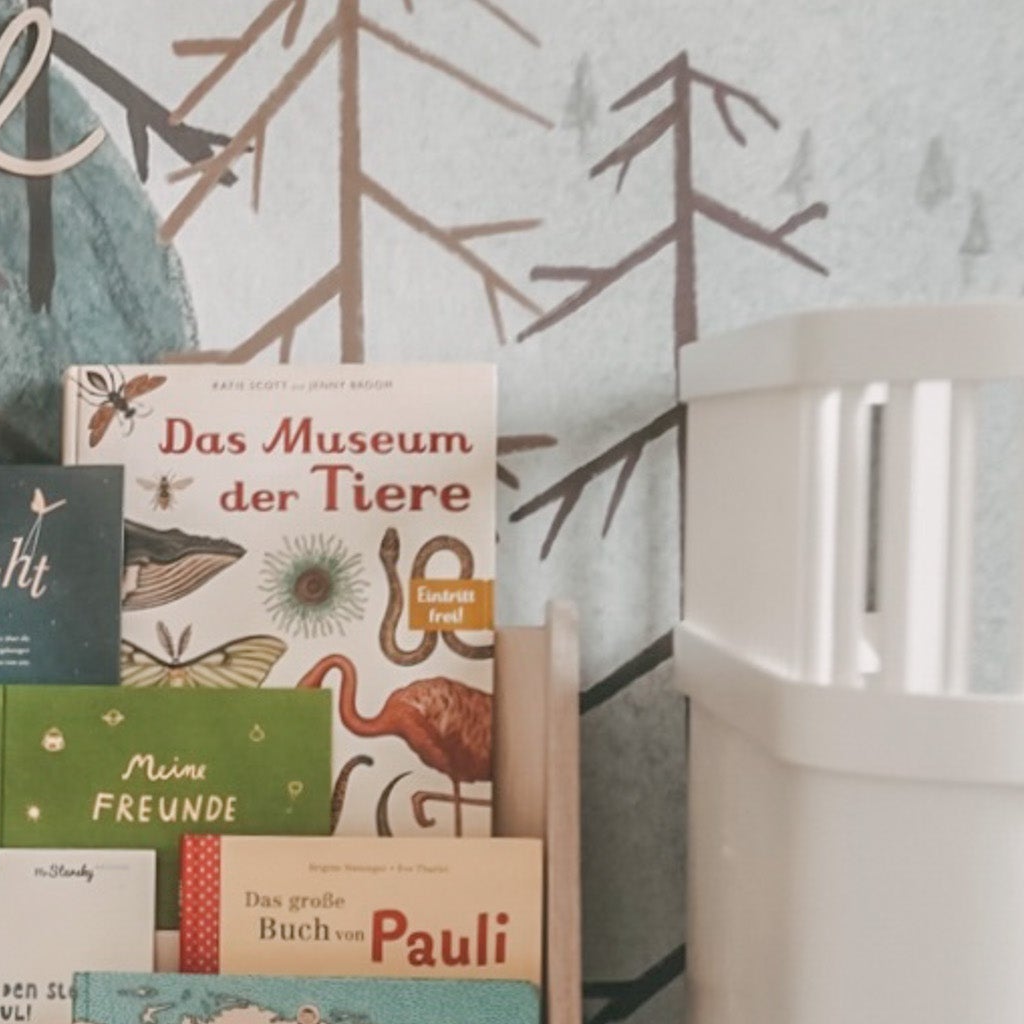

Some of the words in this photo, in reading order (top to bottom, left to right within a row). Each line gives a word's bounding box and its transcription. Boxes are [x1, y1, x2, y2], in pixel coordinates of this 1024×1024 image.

[159, 418, 247, 455] Das
[262, 417, 473, 455] Museum
[219, 481, 299, 512] der
[311, 464, 471, 512] Tiere
[417, 585, 476, 603] Eintritt
[428, 607, 464, 624] frei!
[121, 754, 207, 781] Meine
[92, 793, 237, 822] FREUNDE
[244, 891, 282, 909] Das
[289, 891, 346, 914] große
[258, 917, 330, 943] Buch
[336, 930, 365, 942] von
[371, 908, 510, 968] Pauli
